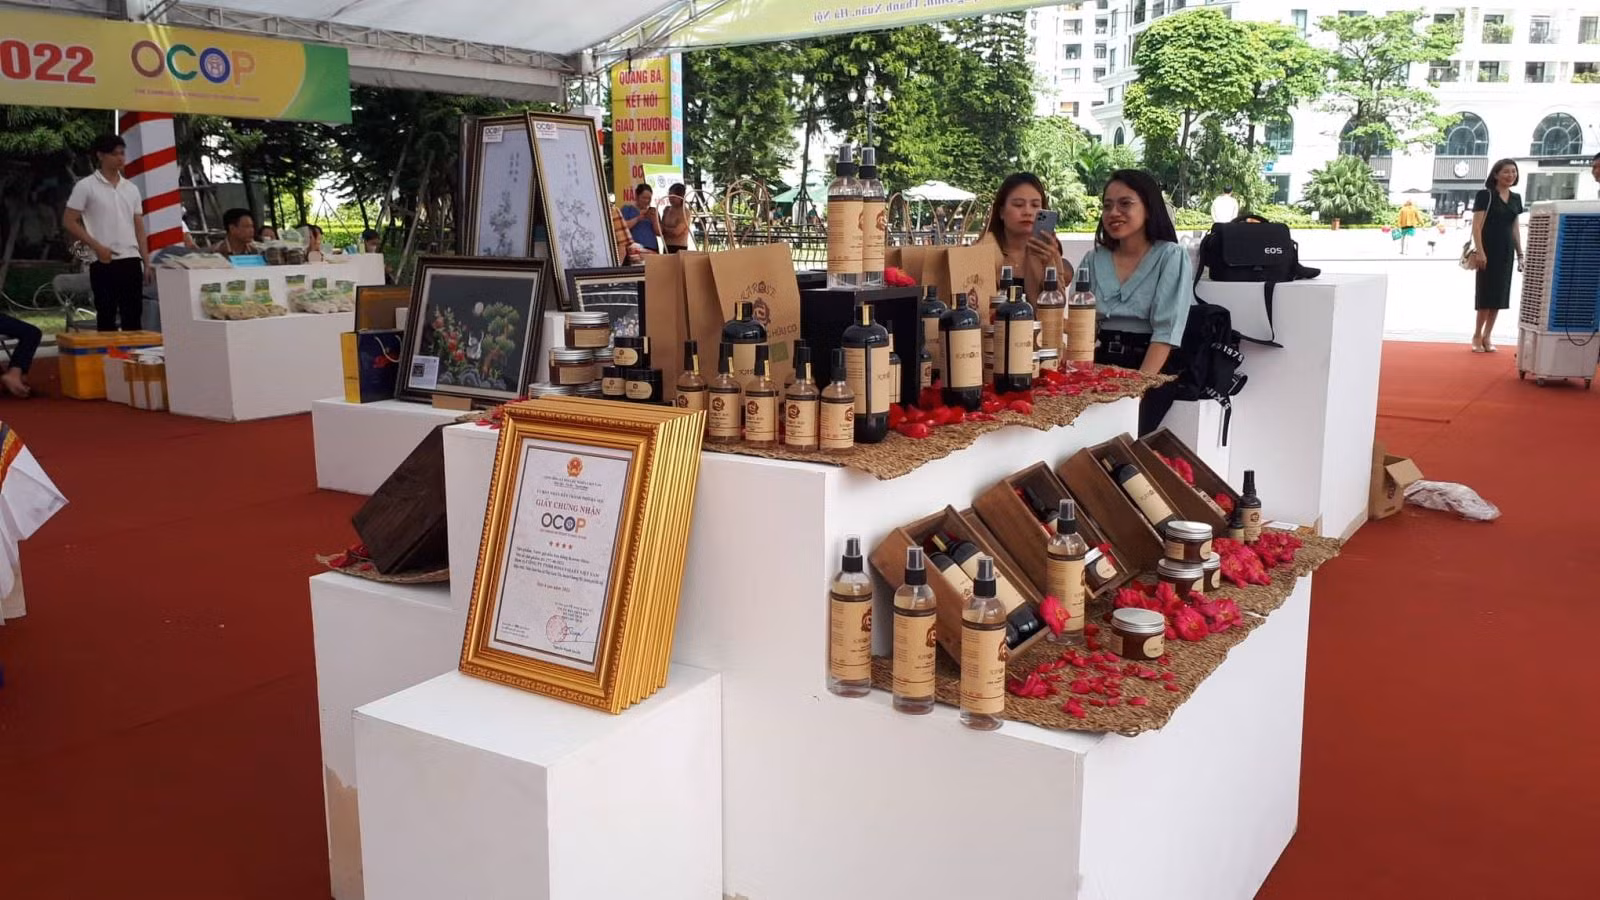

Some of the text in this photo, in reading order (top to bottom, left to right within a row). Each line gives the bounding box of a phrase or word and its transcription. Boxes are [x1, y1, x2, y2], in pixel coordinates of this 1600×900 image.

[131, 40, 256, 85] OCOP
[625, 90, 658, 108] KẾT NỐI
[615, 116, 670, 132] GIAO THƯƠNG
[620, 135, 664, 155] SẢN PHẨM
[1264, 247, 1283, 255] EOS
[1223, 345, 1245, 362] 1975
[535, 497, 553, 509] GIẤY
[579, 504, 601, 516] NHẬN
[541, 512, 587, 534] OCOP
